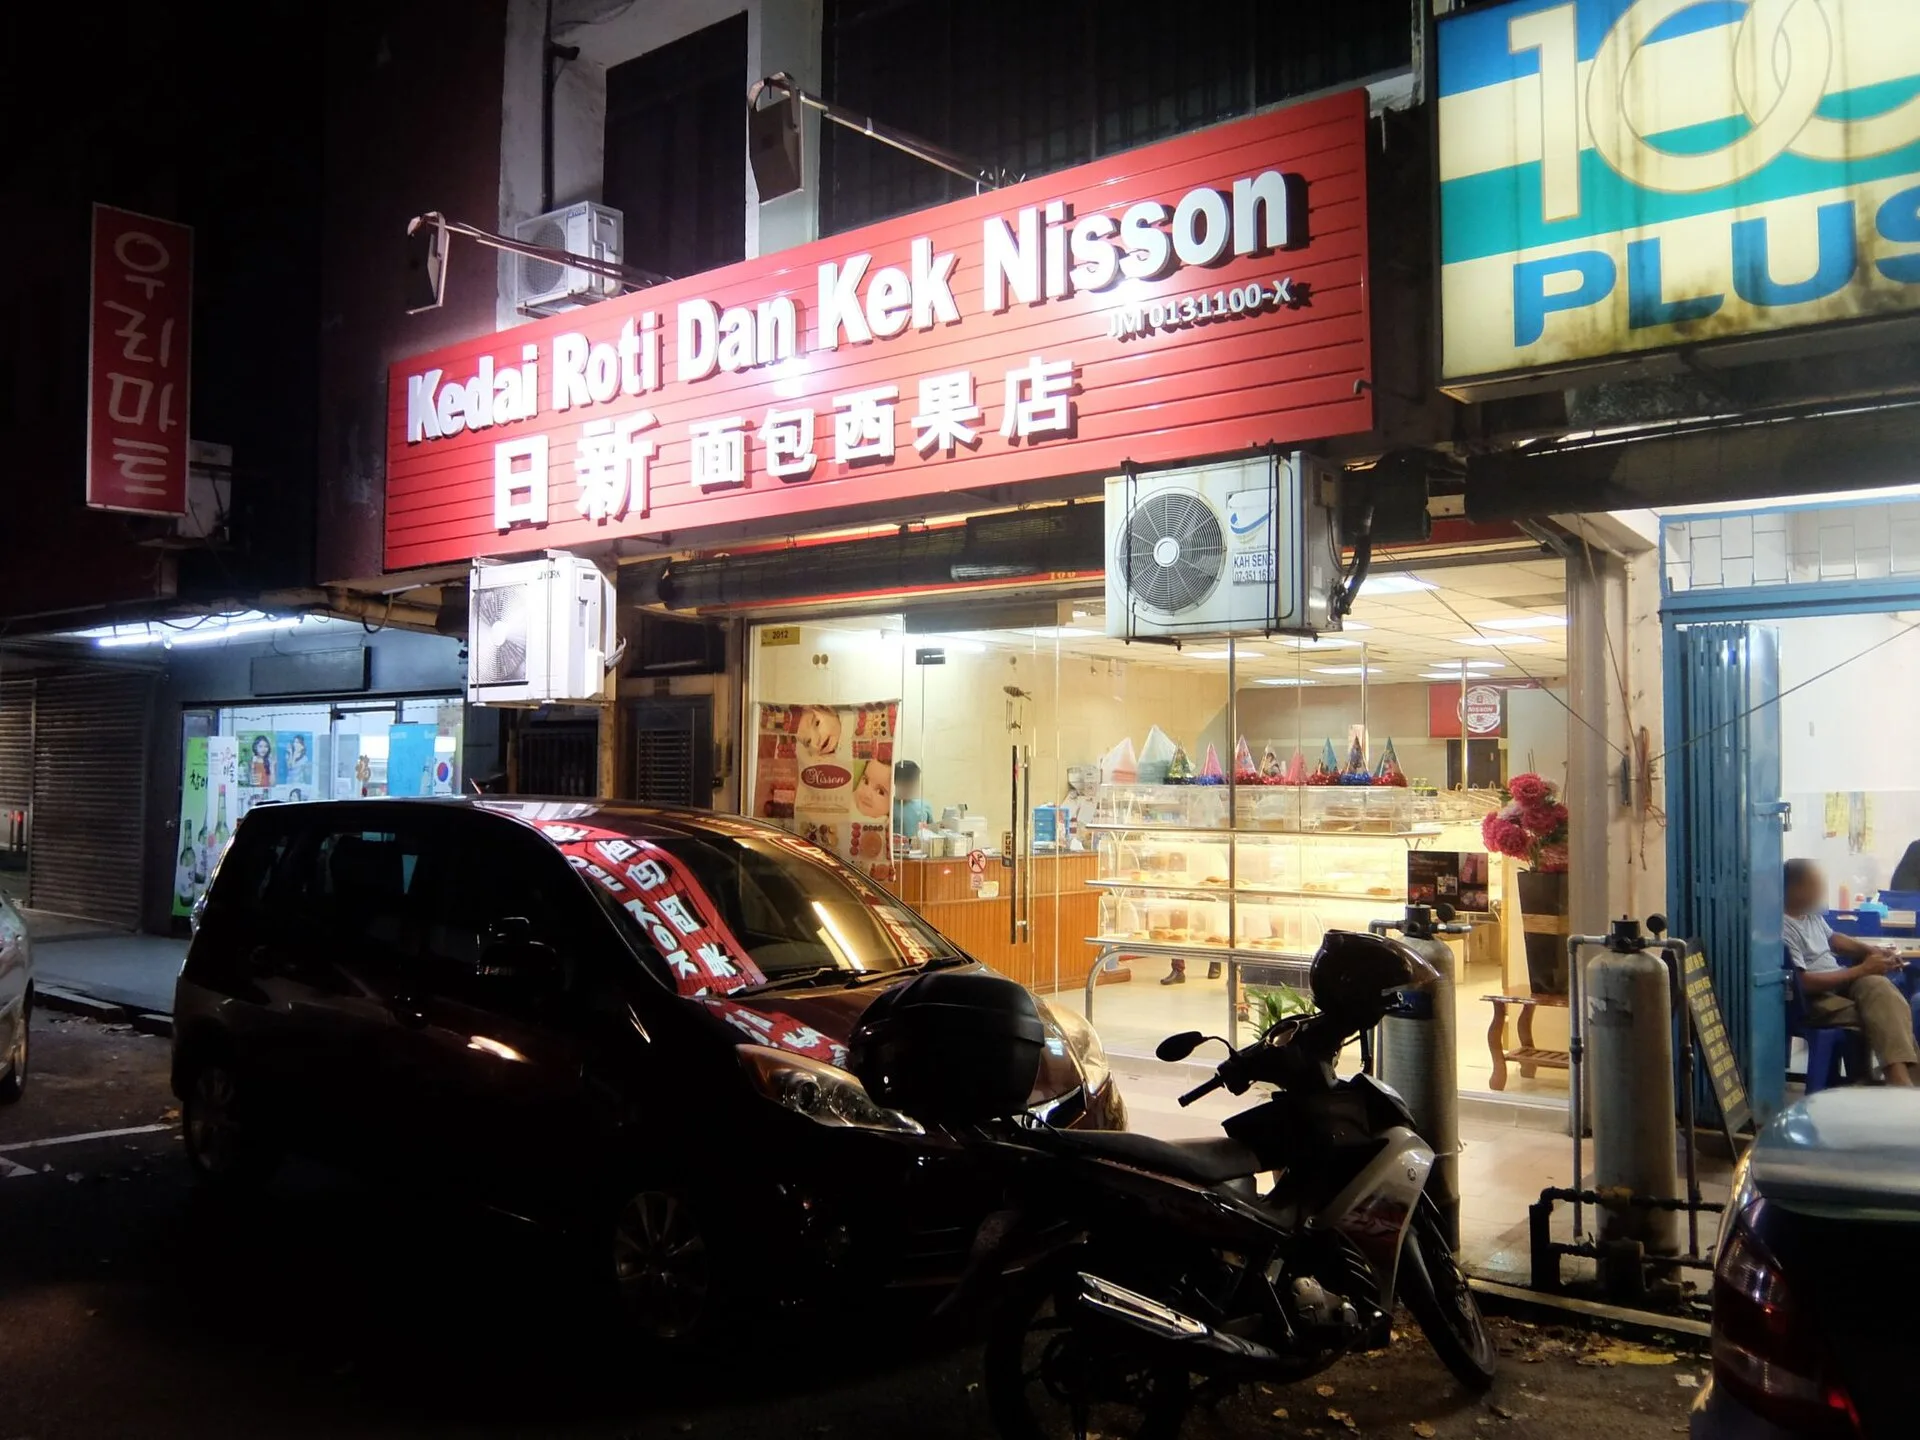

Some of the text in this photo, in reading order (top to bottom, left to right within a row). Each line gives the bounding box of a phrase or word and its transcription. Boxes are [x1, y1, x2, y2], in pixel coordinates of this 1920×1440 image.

[408, 170, 1289, 445] Kedai Roti Dan Kek Nisson
[1108, 276, 1293, 339] JM 0131100-X
[103, 230, 178, 497] 우리마트
[1233, 555, 1250, 568] KAH
[772, 630, 789, 640] 2012
